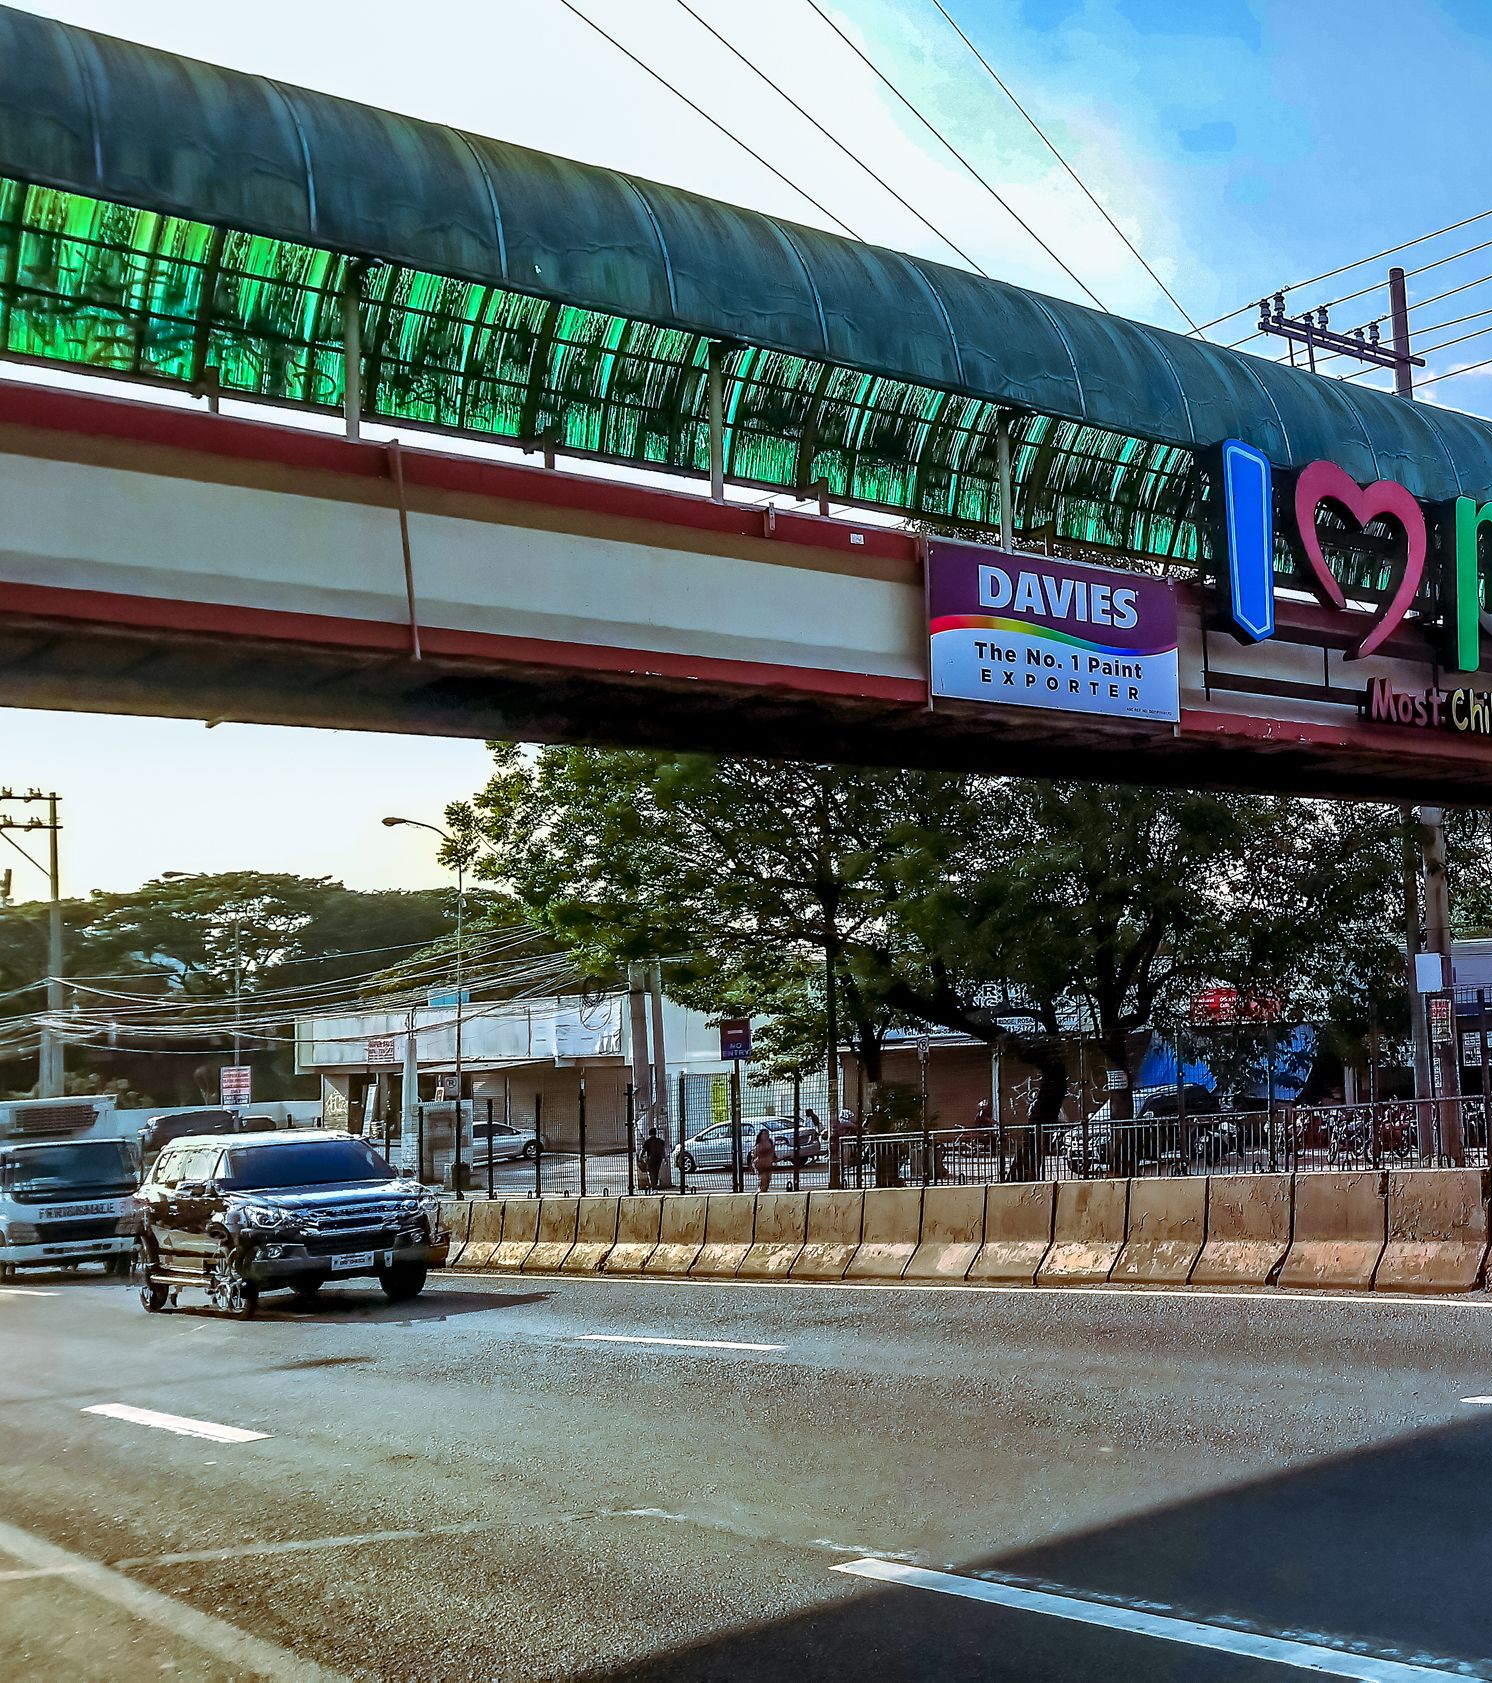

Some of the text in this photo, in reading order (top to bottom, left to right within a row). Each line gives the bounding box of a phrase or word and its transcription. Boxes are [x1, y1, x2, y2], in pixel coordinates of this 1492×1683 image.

[977, 563, 1139, 630] DAVIES
[974, 640, 1143, 680] The No. 1 Paint
[980, 668, 1140, 701] EXPORTER
[1371, 676, 1440, 727] Most
[722, 1049, 750, 1057] ENTRY
